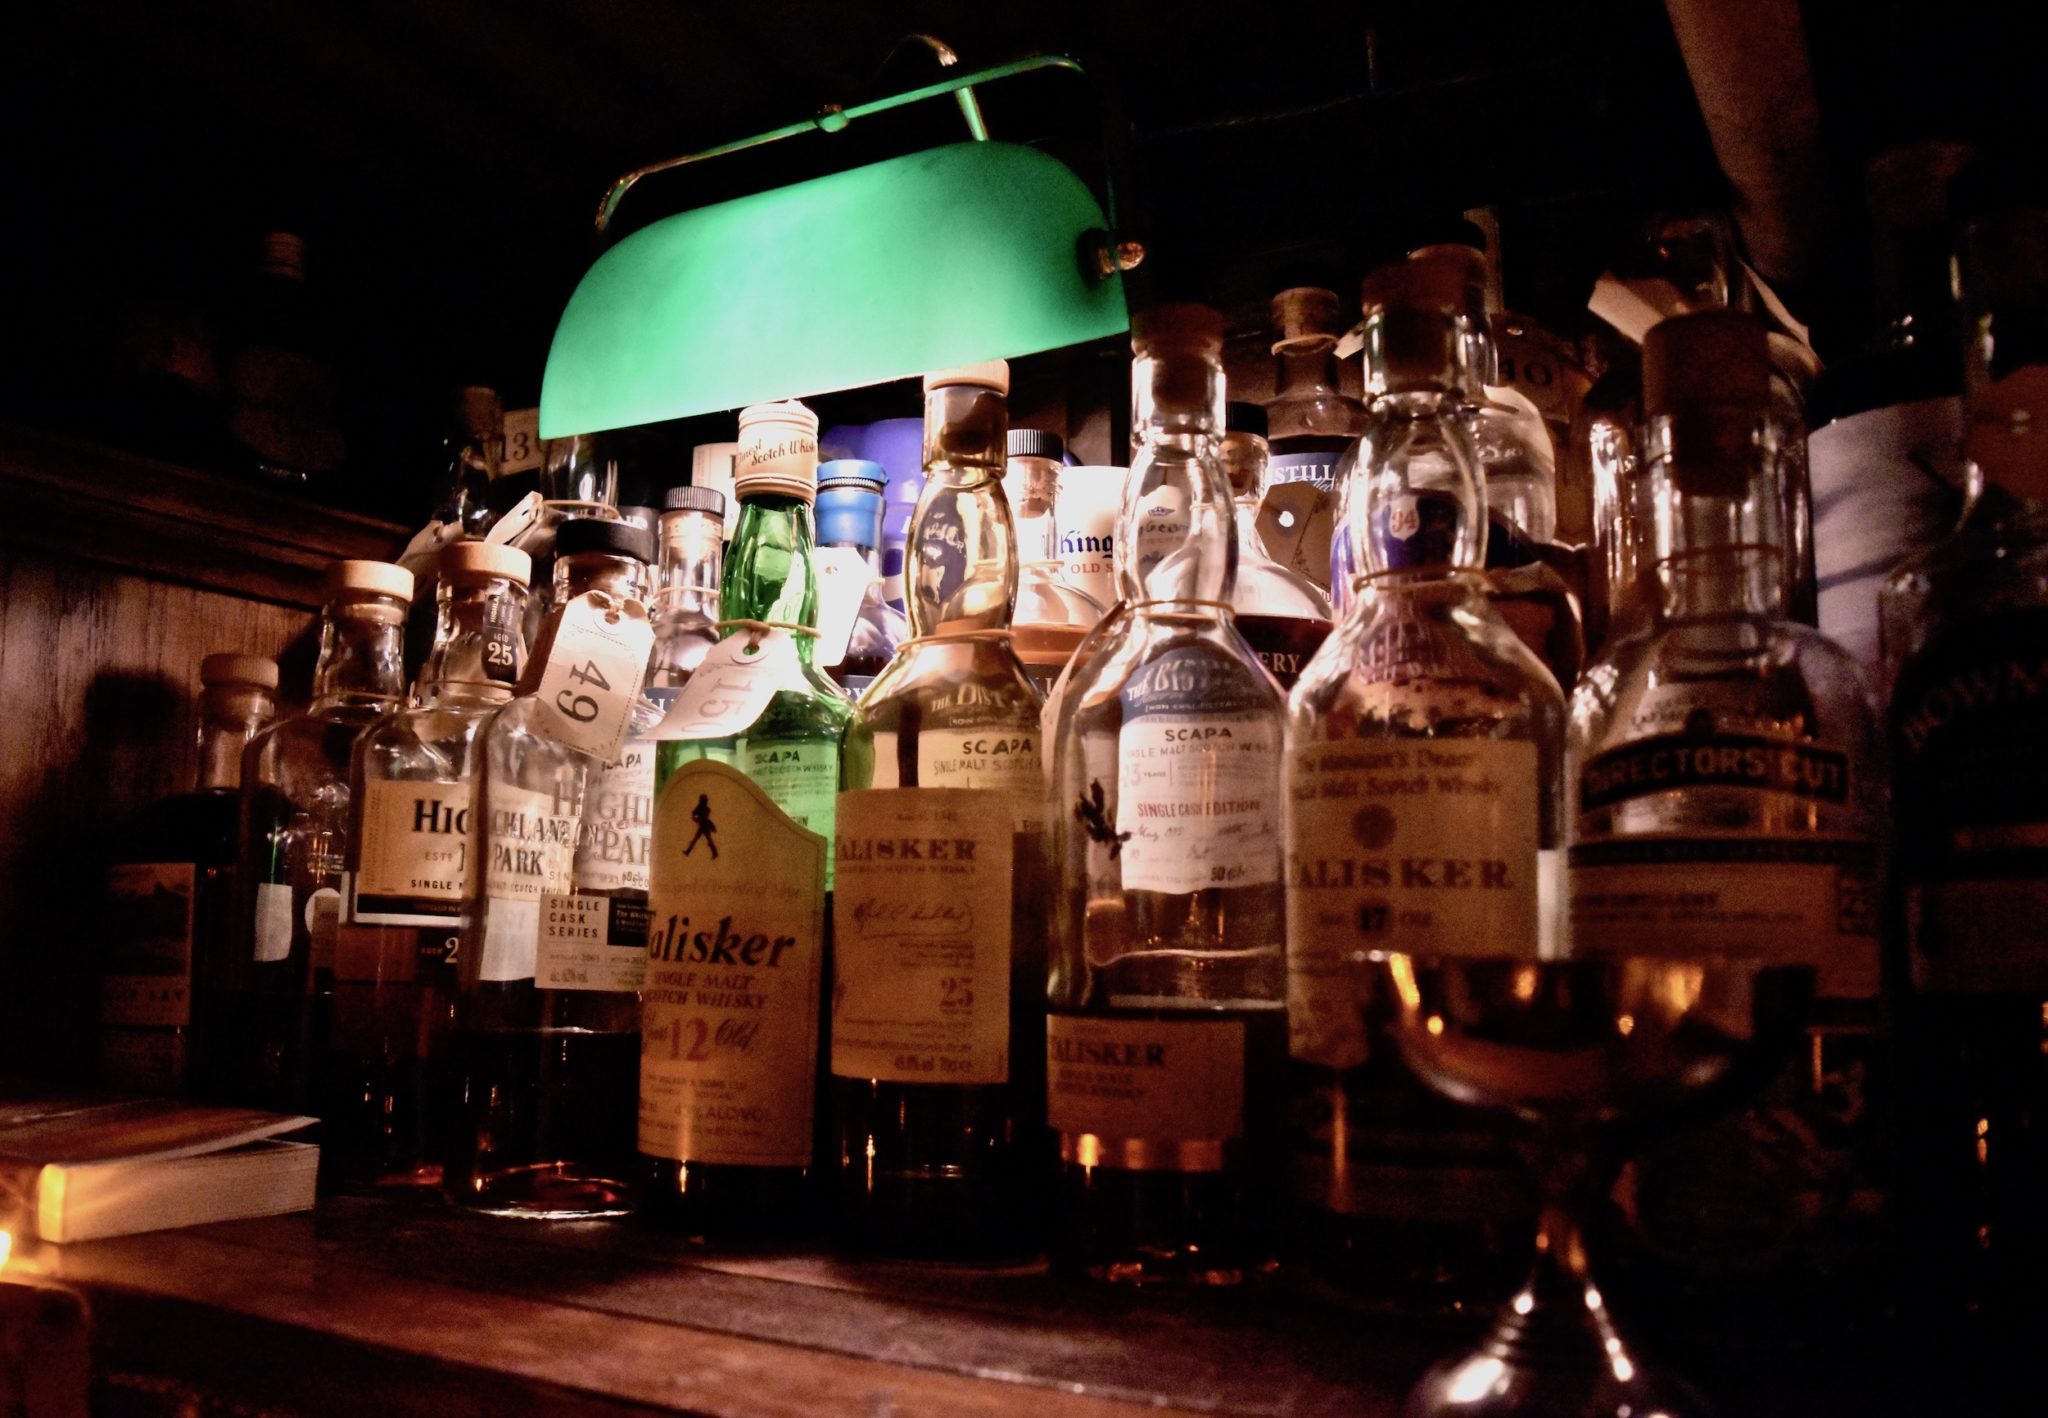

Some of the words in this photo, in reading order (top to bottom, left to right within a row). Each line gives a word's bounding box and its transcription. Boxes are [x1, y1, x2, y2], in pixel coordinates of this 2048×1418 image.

[751, 442, 786, 467] Scotch
[1070, 563, 1101, 575] OLD
[487, 641, 514, 666] 25
[1164, 726, 1233, 742] SCAPA
[962, 738, 1033, 755] SCAPA
[754, 749, 801, 765] SCAPA
[1137, 802, 1177, 818] SINGLE
[836, 838, 976, 862] ALISKER
[493, 842, 544, 876] PARK
[1296, 859, 1515, 890] ALISKER
[411, 879, 453, 891] SINGLE
[550, 899, 601, 912] SINGLE
[550, 913, 586, 925] CASK
[549, 926, 599, 939] SERIES
[702, 974, 756, 990] MALT
[939, 976, 974, 1008] 25
[697, 992, 768, 1010] WHISKY
[671, 1017, 709, 1062] 12
[1052, 1036, 1166, 1068] ALISKER
